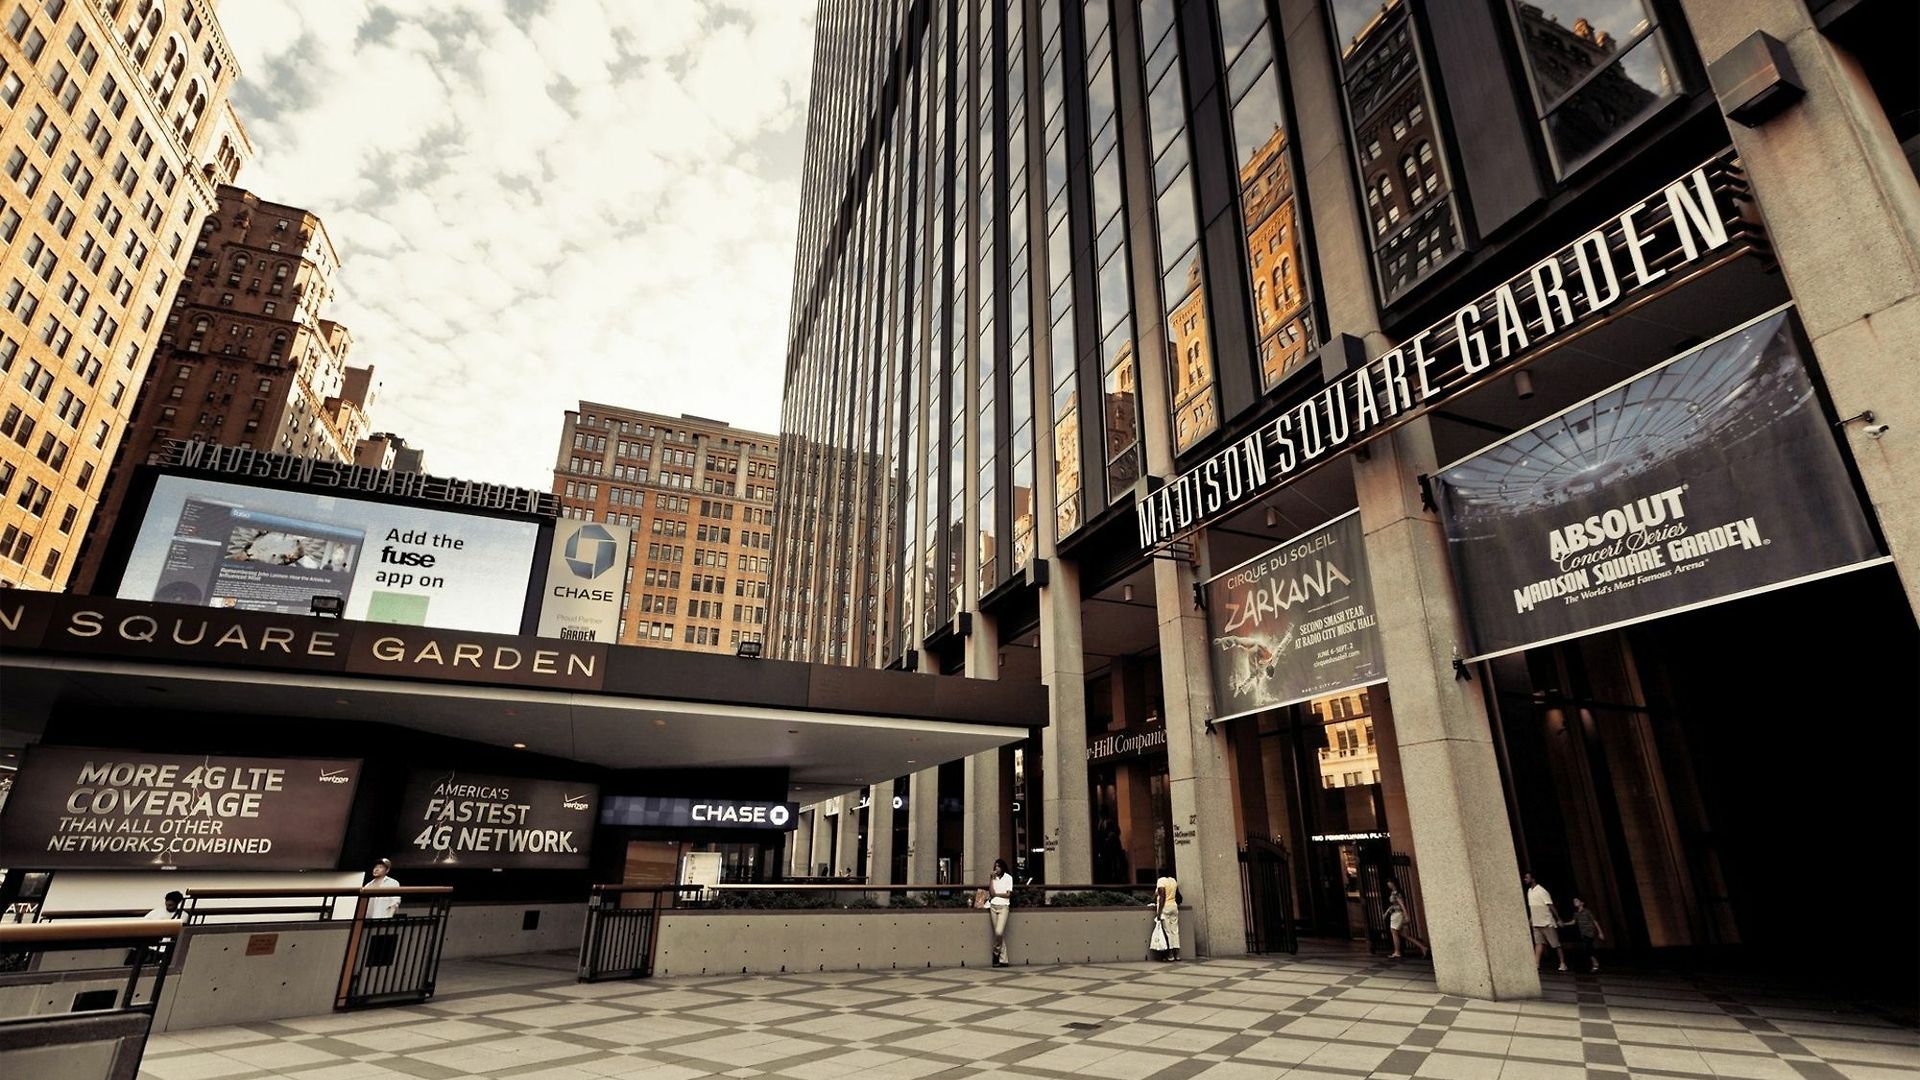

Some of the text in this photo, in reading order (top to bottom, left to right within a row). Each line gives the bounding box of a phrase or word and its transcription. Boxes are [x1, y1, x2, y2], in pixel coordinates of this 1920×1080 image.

[1137, 168, 1732, 549] MADISON SQUARE GARDEN
[180, 440, 541, 514] MADISON SQUARE GARDEN
[1550, 486, 1685, 560] ABSOLUT
[385, 528, 464, 550] Add the
[1554, 522, 1688, 574] Concert Series
[381, 546, 435, 568] fuse
[1227, 533, 1336, 590] CIRQUE DU SOLEIL
[1513, 517, 1762, 614] MADISON SQUARE GARDEN
[375, 571, 444, 588] app on
[1564, 561, 1705, 605] The World's Most Famous Arena
[554, 586, 614, 602] CHASE
[1224, 559, 1351, 633] ZARKANA
[557, 613, 603, 624] Proud Partner
[1294, 614, 1377, 649] AT RADIO CITY MUSIC HALL
[1299, 605, 1365, 636] SECOND SMASH YEAR
[66, 610, 340, 657] SQUARE
[372, 637, 596, 677] GARDEN
[560, 627, 596, 642] GARDEN
[76, 761, 286, 792] MORE 4G LTE
[319, 775, 349, 785] verizon
[66, 788, 262, 818] COVERAGE
[434, 783, 510, 800] AMERICA'S
[424, 799, 531, 825] FASTEST
[563, 802, 589, 811] verizon
[691, 804, 767, 823] CHASE
[58, 816, 223, 835] THAN ALL OTHER
[413, 825, 578, 853] 4G NETWORK.
[47, 835, 272, 854] NETWORKS COMBINED
[5, 902, 39, 914] ATM
